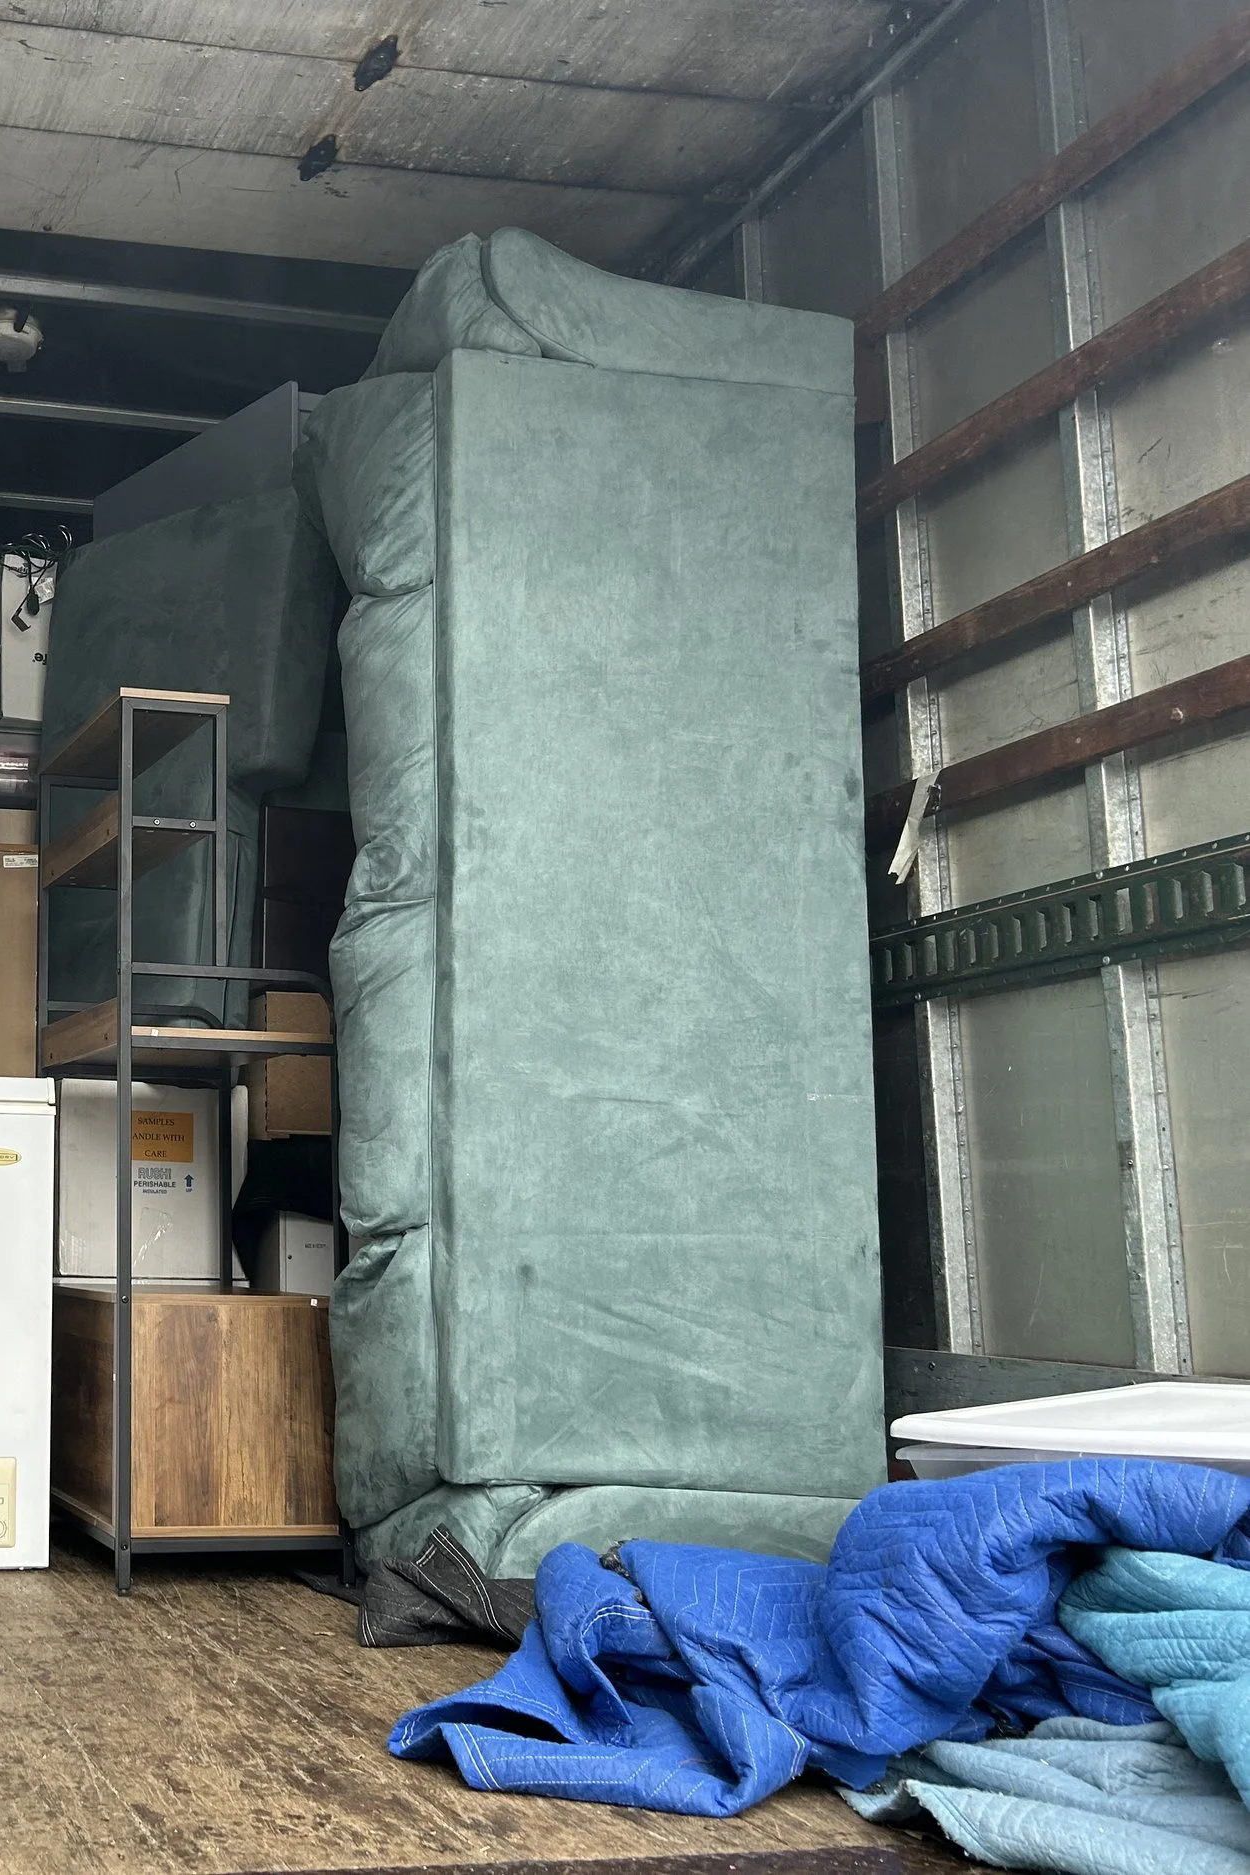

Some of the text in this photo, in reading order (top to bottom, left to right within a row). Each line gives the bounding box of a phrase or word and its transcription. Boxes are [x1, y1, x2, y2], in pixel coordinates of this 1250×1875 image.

[137, 1117, 175, 1126] SAMPLES
[133, 1132, 185, 1142] ANDLE WITH
[144, 1149, 167, 1158] CARE
